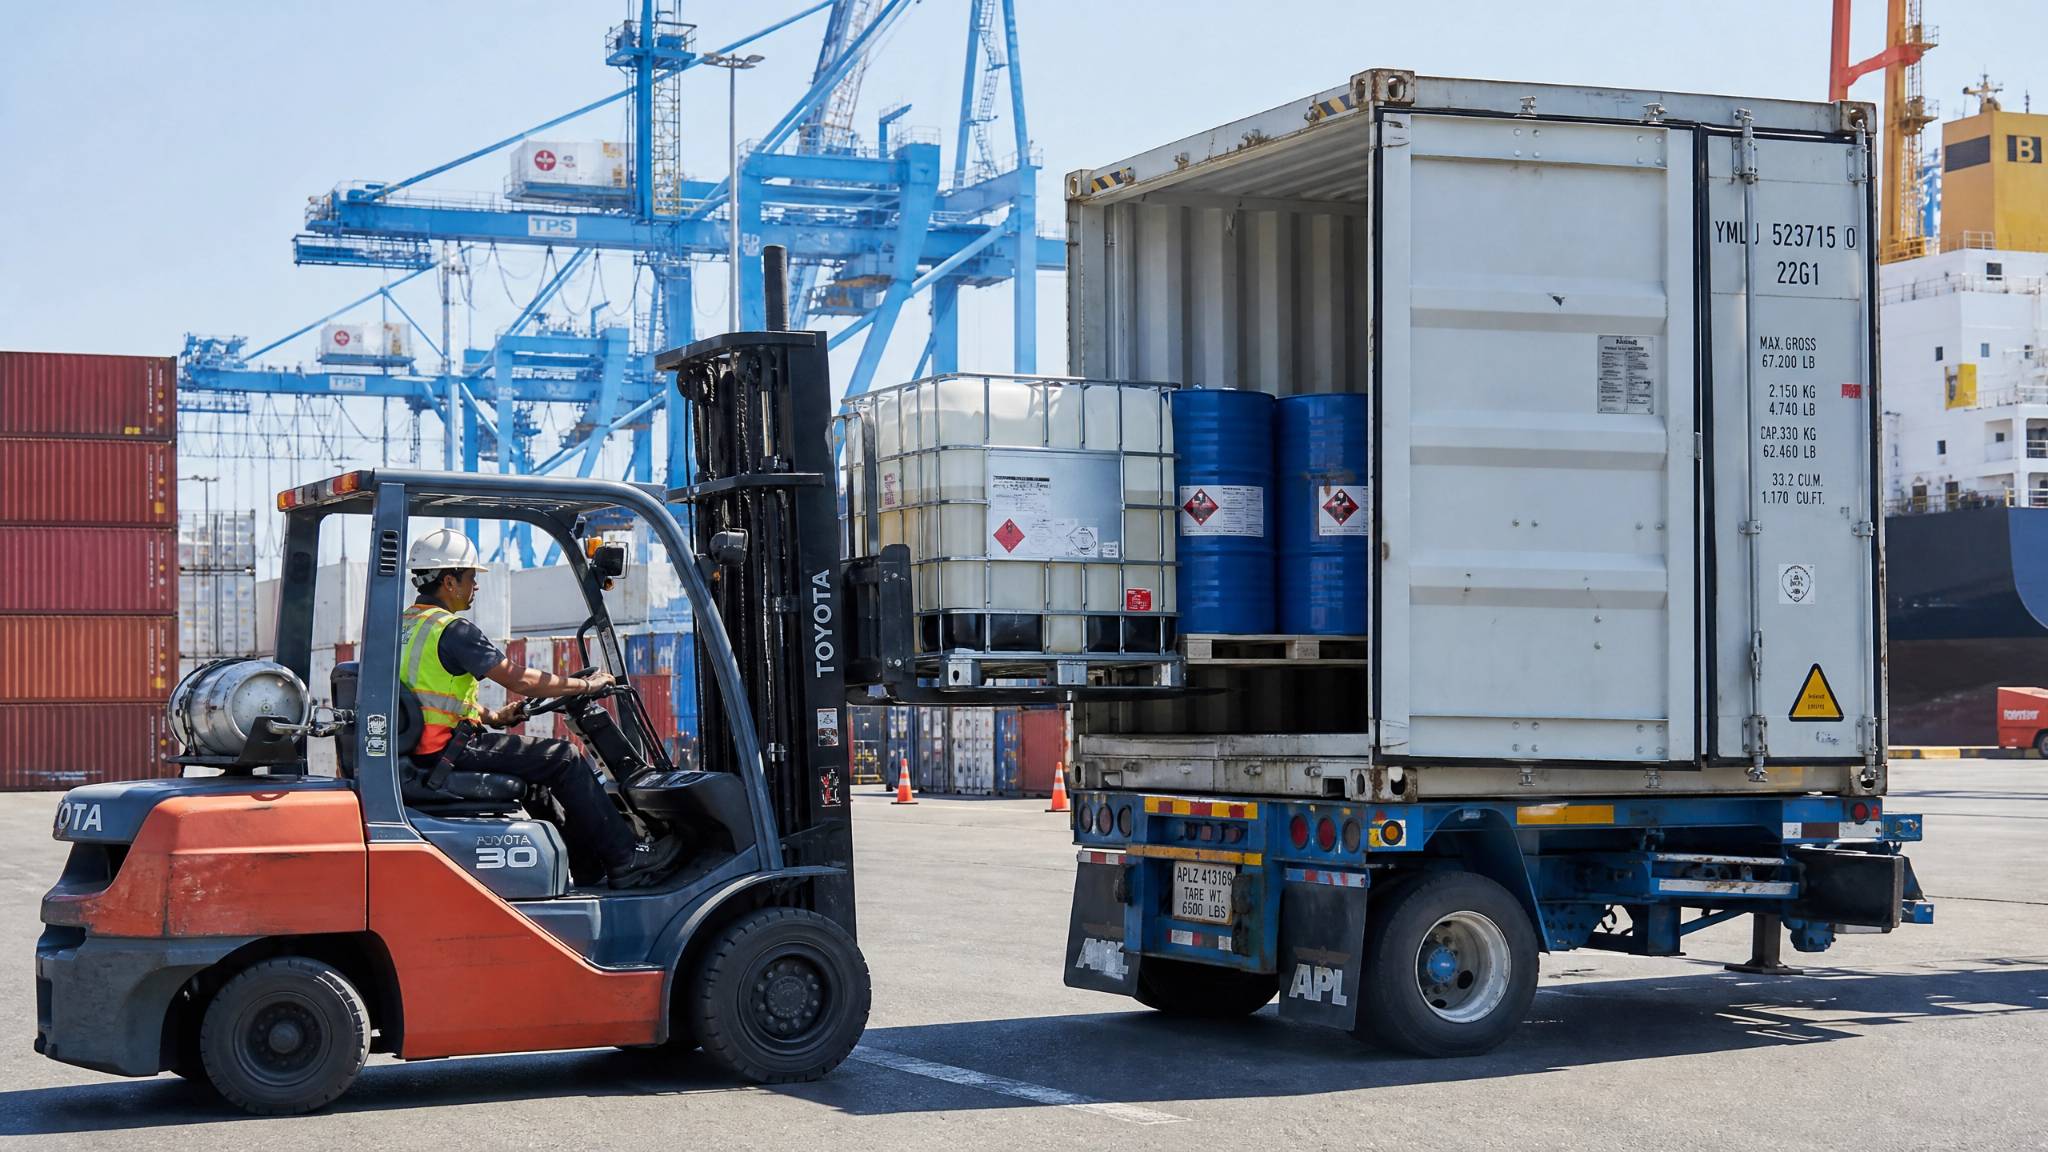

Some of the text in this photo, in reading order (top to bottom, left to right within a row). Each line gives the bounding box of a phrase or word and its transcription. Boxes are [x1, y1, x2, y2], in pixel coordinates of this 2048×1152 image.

[2016, 136, 2034, 162] B
[531, 217, 572, 232] TPS
[1772, 223, 1836, 249] 523715
[1777, 261, 1819, 286] 22G1
[1760, 336, 1817, 351] MAX. GROSS
[1762, 354, 1816, 369] 67.200 LB
[1769, 384, 1816, 399] 2.150 KG
[1769, 401, 1816, 416] 4.740 LB
[1803, 427, 1817, 441] KG
[1763, 444, 1816, 459] 62.460 LB
[1772, 473, 1794, 487] 33.2
[1762, 490, 1789, 504] 1.170
[812, 569, 835, 678] TOYOTA
[475, 847, 538, 869] 30
[1176, 866, 1233, 887] APLZ 413169
[1183, 886, 1224, 903] TARE WT.
[1182, 900, 1226, 919] 6500 LBS
[1288, 963, 1348, 1007] APL
